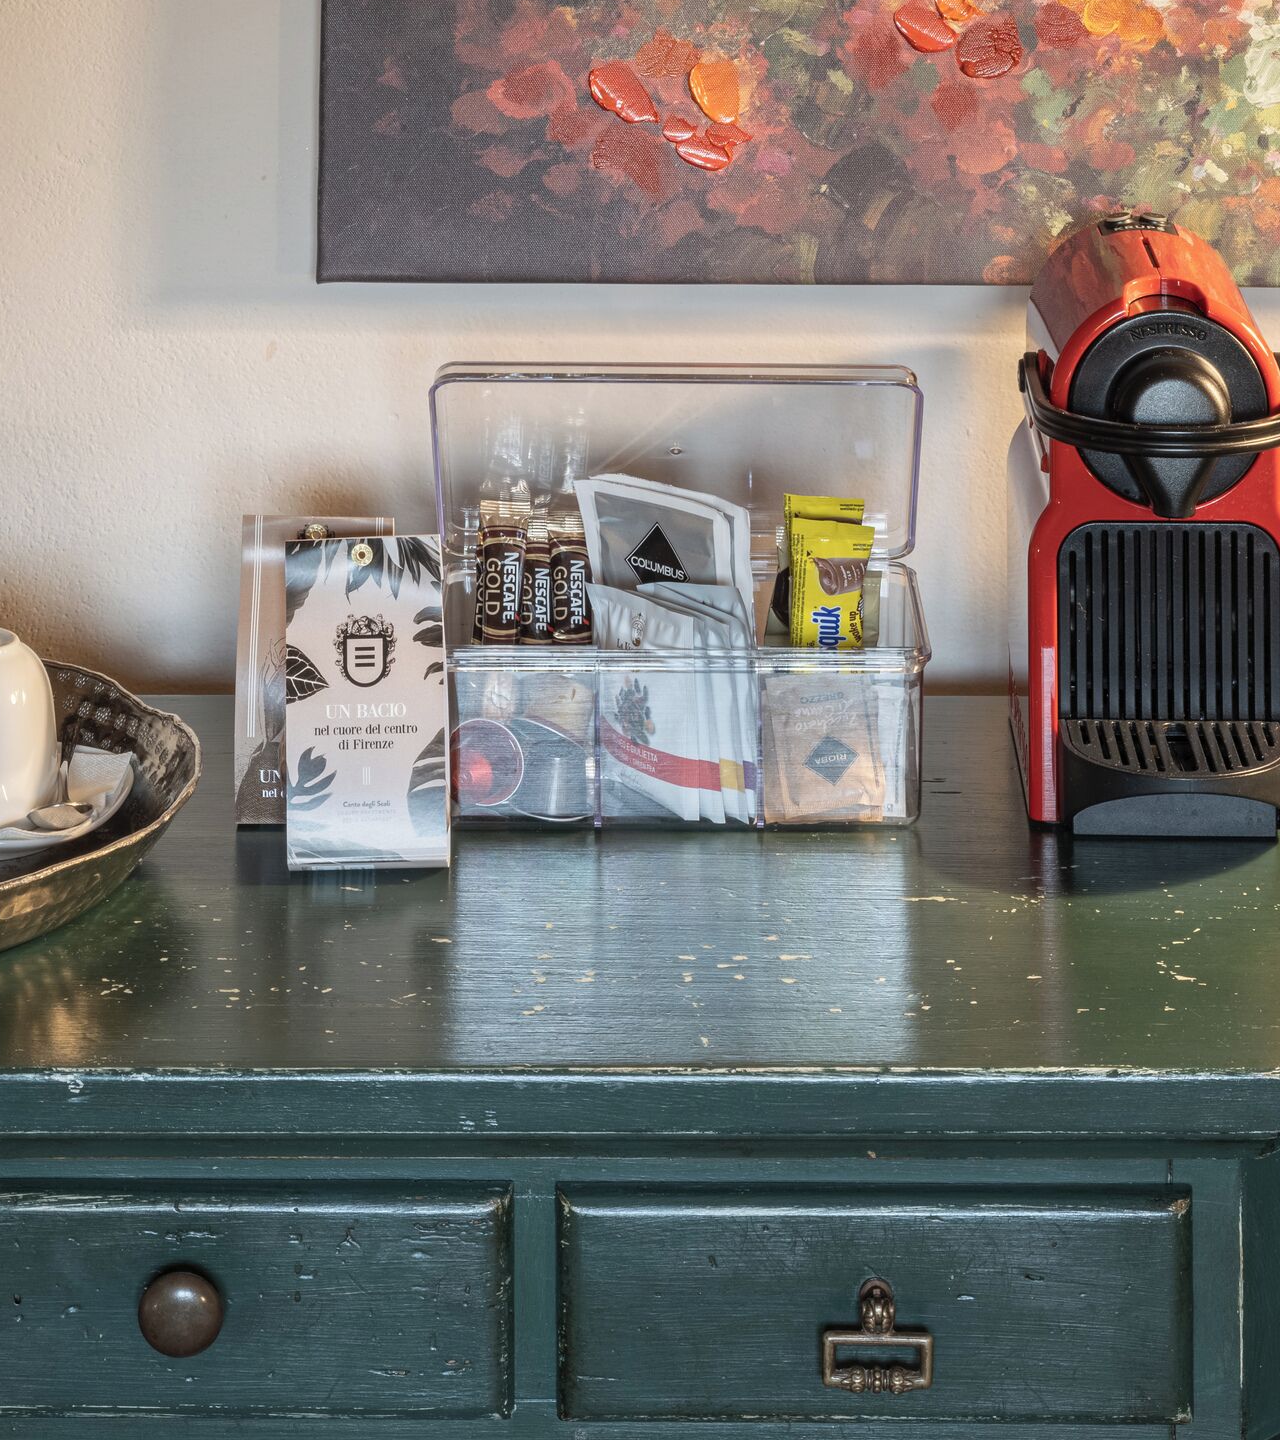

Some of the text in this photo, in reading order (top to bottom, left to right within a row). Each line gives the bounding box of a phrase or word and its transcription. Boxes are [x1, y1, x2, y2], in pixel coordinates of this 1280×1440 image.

[1129, 322, 1207, 342] NESPRESSO
[631, 556, 684, 581] COLUMBUS
[486, 558, 501, 616] GOLD
[553, 566, 567, 621] GOLD
[849, 610, 858, 622] up
[326, 703, 406, 719] UN BACIO
[314, 724, 418, 736] nel cuore del centro
[338, 739, 393, 750] di Firenze
[815, 753, 847, 764] RIOBA
[262, 789, 277, 798] nel
